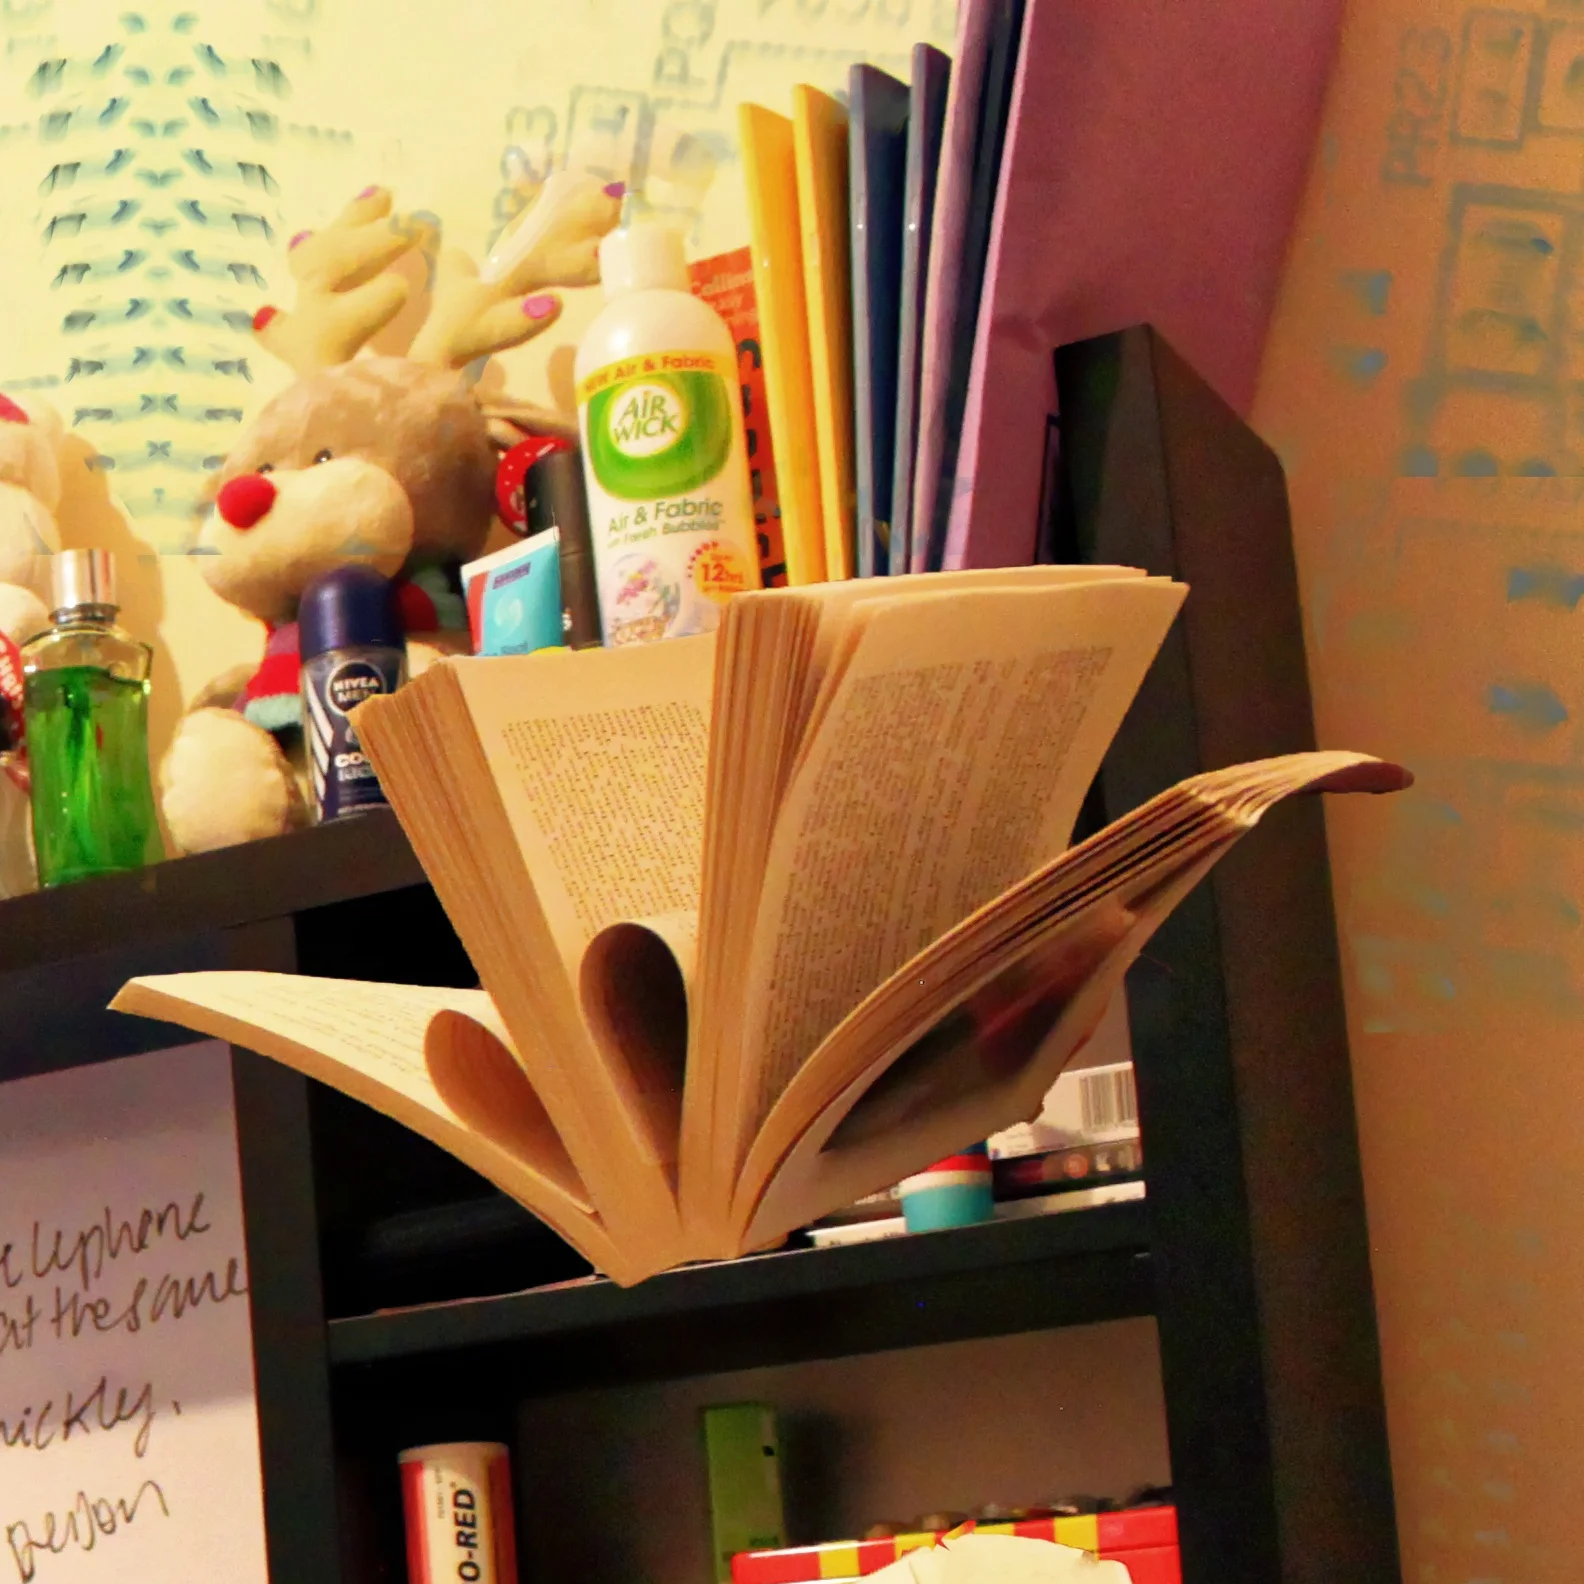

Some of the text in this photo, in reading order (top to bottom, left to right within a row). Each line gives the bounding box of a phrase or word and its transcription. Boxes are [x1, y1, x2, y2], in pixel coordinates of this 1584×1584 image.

[613, 364, 637, 381] Air
[661, 354, 716, 371] Fabric
[613, 414, 680, 444] WICK
[608, 514, 630, 534] Air
[654, 498, 724, 522] Fabric
[332, 676, 381, 693] NIVEA
